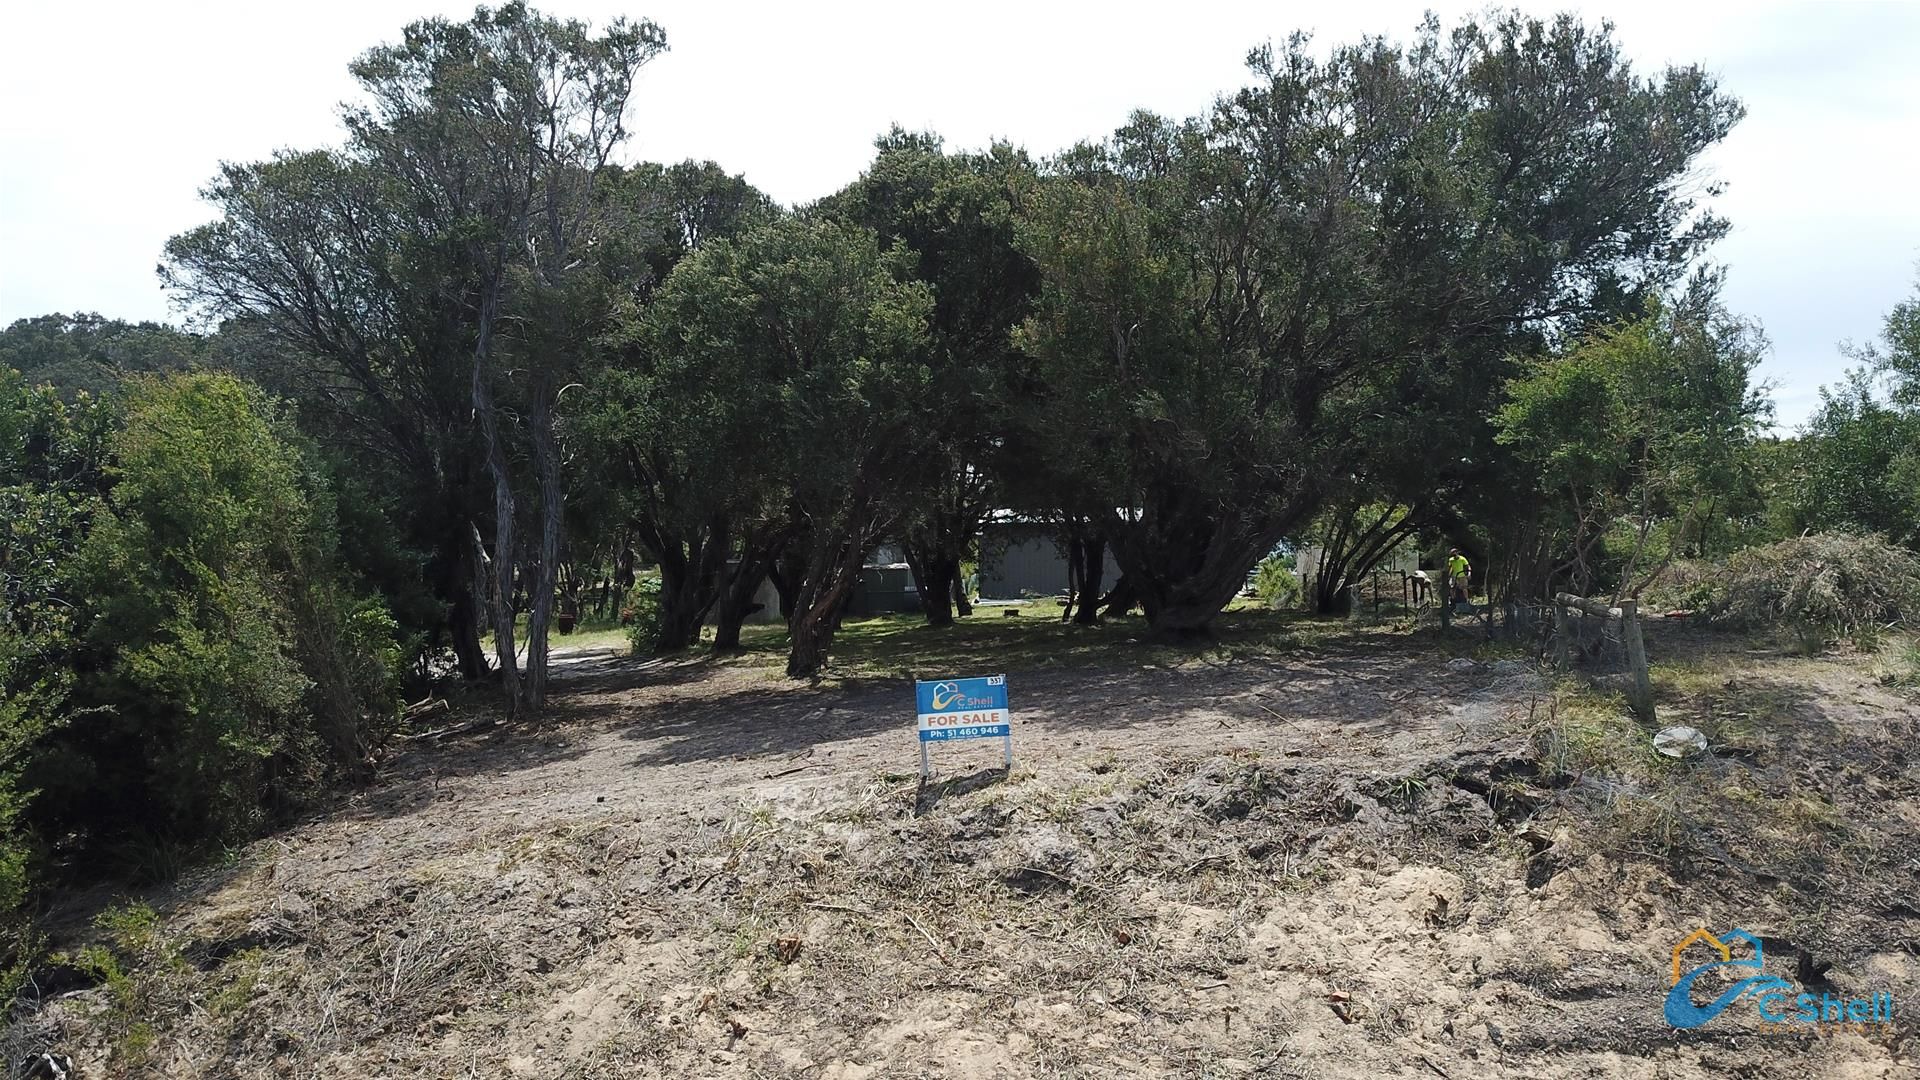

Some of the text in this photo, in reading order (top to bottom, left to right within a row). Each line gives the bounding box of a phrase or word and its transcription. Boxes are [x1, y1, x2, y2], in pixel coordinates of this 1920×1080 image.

[957, 696, 993, 706] C Shell
[928, 713, 1000, 727] FOR SALE
[930, 730, 945, 738] Ph:
[947, 729, 957, 737] 51
[959, 728, 978, 736] 460
[980, 726, 999, 735] 946
